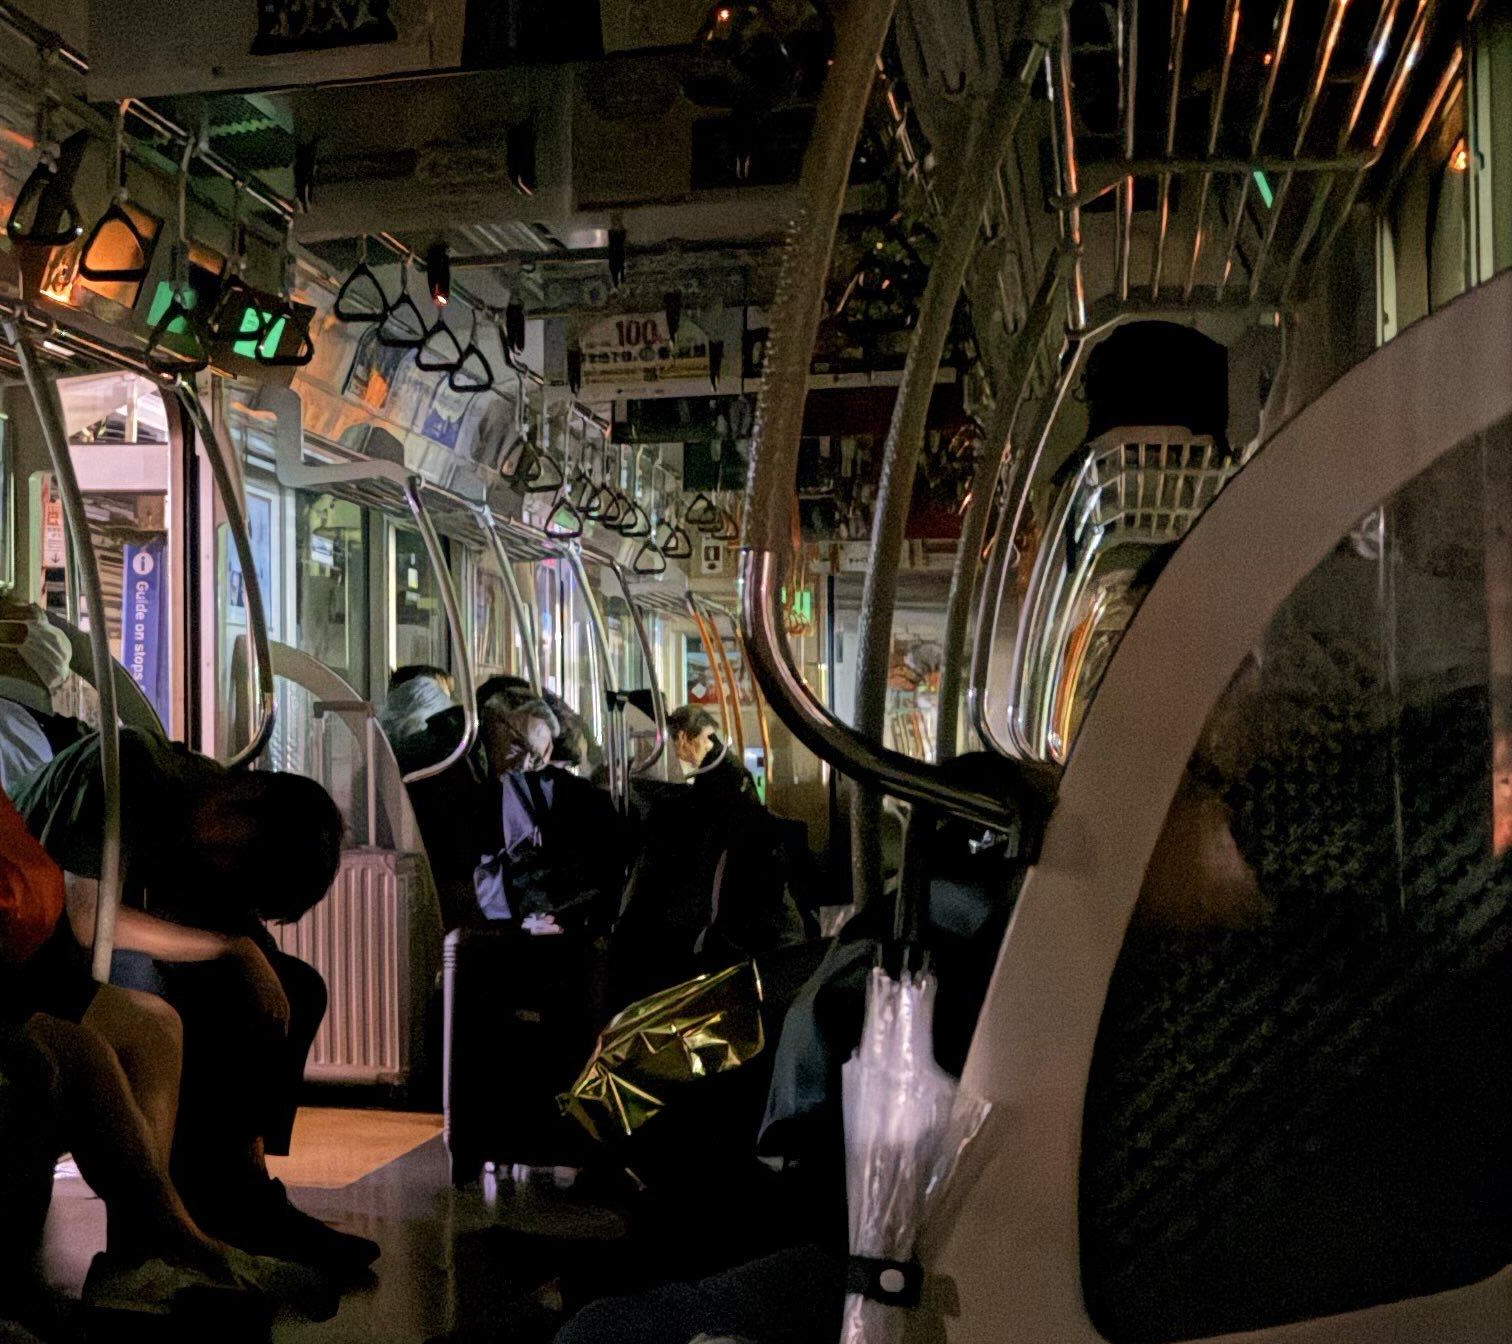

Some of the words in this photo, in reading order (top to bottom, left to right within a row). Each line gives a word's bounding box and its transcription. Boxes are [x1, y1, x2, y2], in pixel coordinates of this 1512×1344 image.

[134, 581, 149, 621] Guide
[134, 623, 145, 641] on
[131, 644, 147, 681] stops
